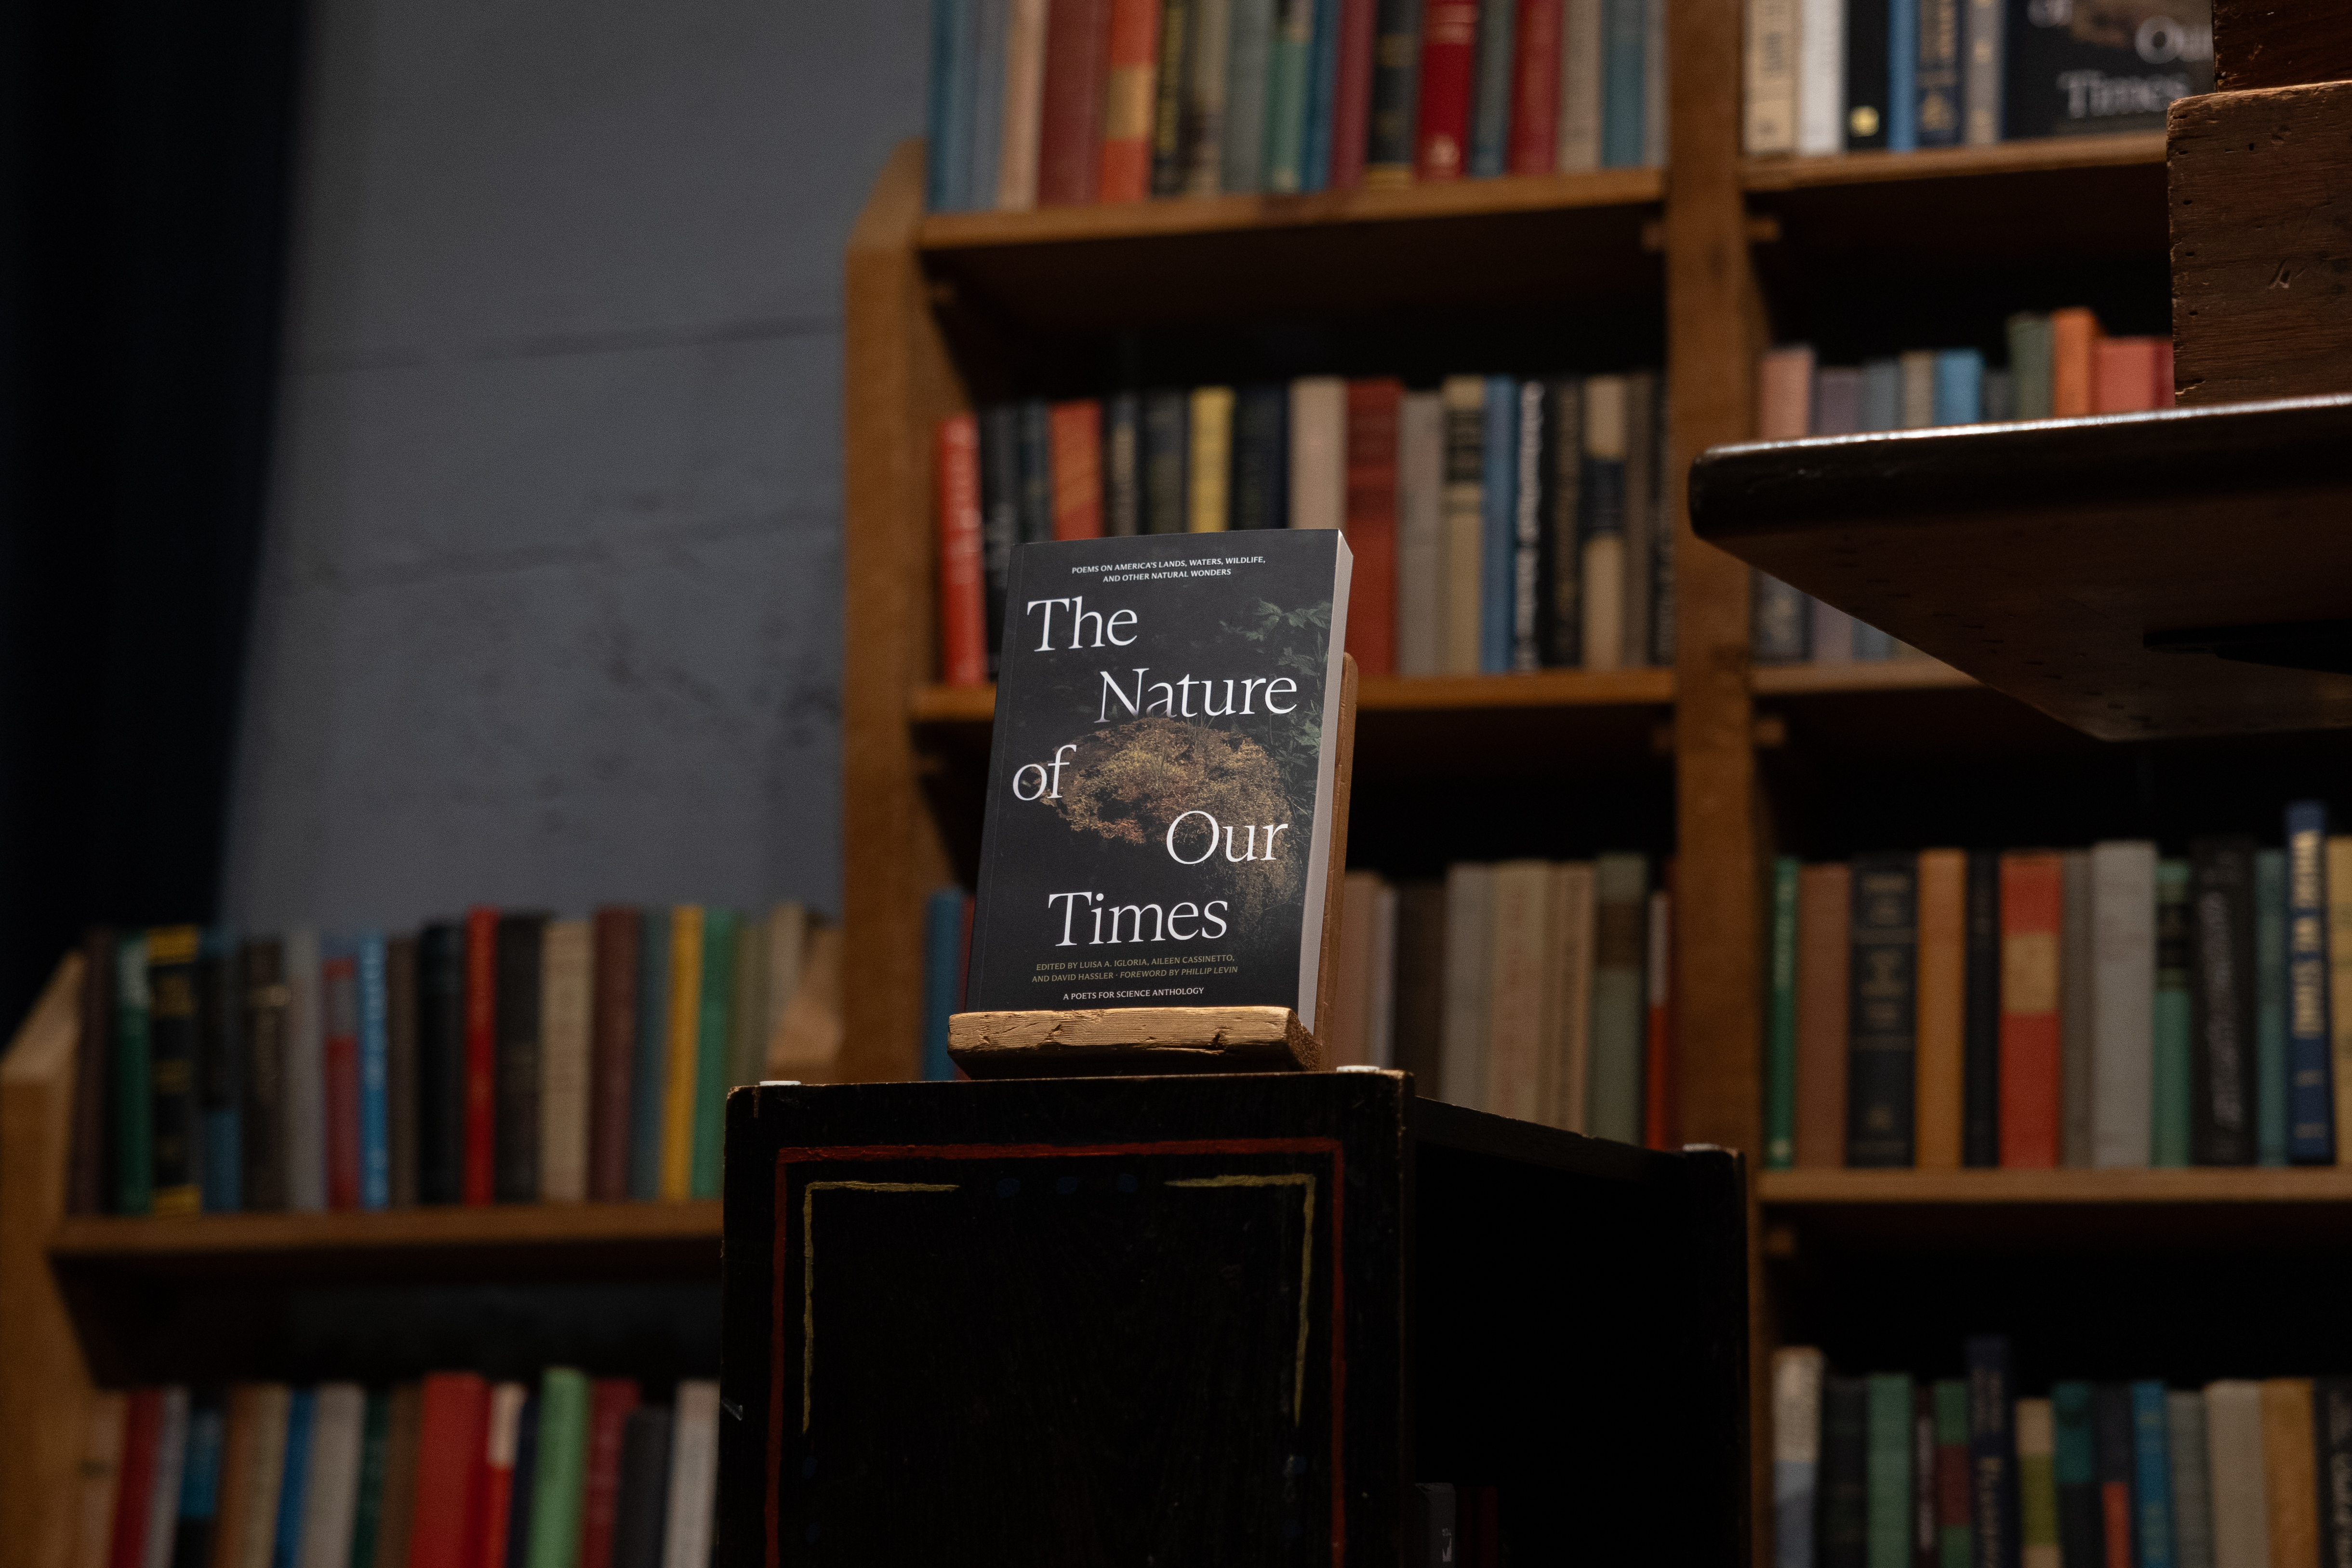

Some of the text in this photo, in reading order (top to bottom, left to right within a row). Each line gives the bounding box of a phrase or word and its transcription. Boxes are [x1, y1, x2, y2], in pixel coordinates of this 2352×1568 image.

[1072, 565, 1099, 574] POEMS
[1114, 561, 1157, 571] AMERICA'S
[1158, 560, 1187, 568] LANDS,
[1189, 558, 1223, 566] WATERS,
[1225, 556, 1266, 564] WILDLIFE,
[1122, 573, 1150, 581] OTHER
[1151, 571, 1189, 579] NATURAL
[1190, 569, 1231, 577] WONDERS
[1026, 596, 1138, 652] The
[1094, 667, 1297, 723] Nature
[1012, 744, 1077, 801] of
[1166, 810, 1289, 864] Our
[1048, 891, 1228, 946] Times
[1114, 958, 1149, 967] IGLORIA,
[1182, 954, 1235, 963] CASSINETTO,
[1120, 970, 1167, 978] FOREWORD
[1116, 989, 1151, 998] SCIENCE
[1152, 987, 1204, 996] ANTHOLOGY
